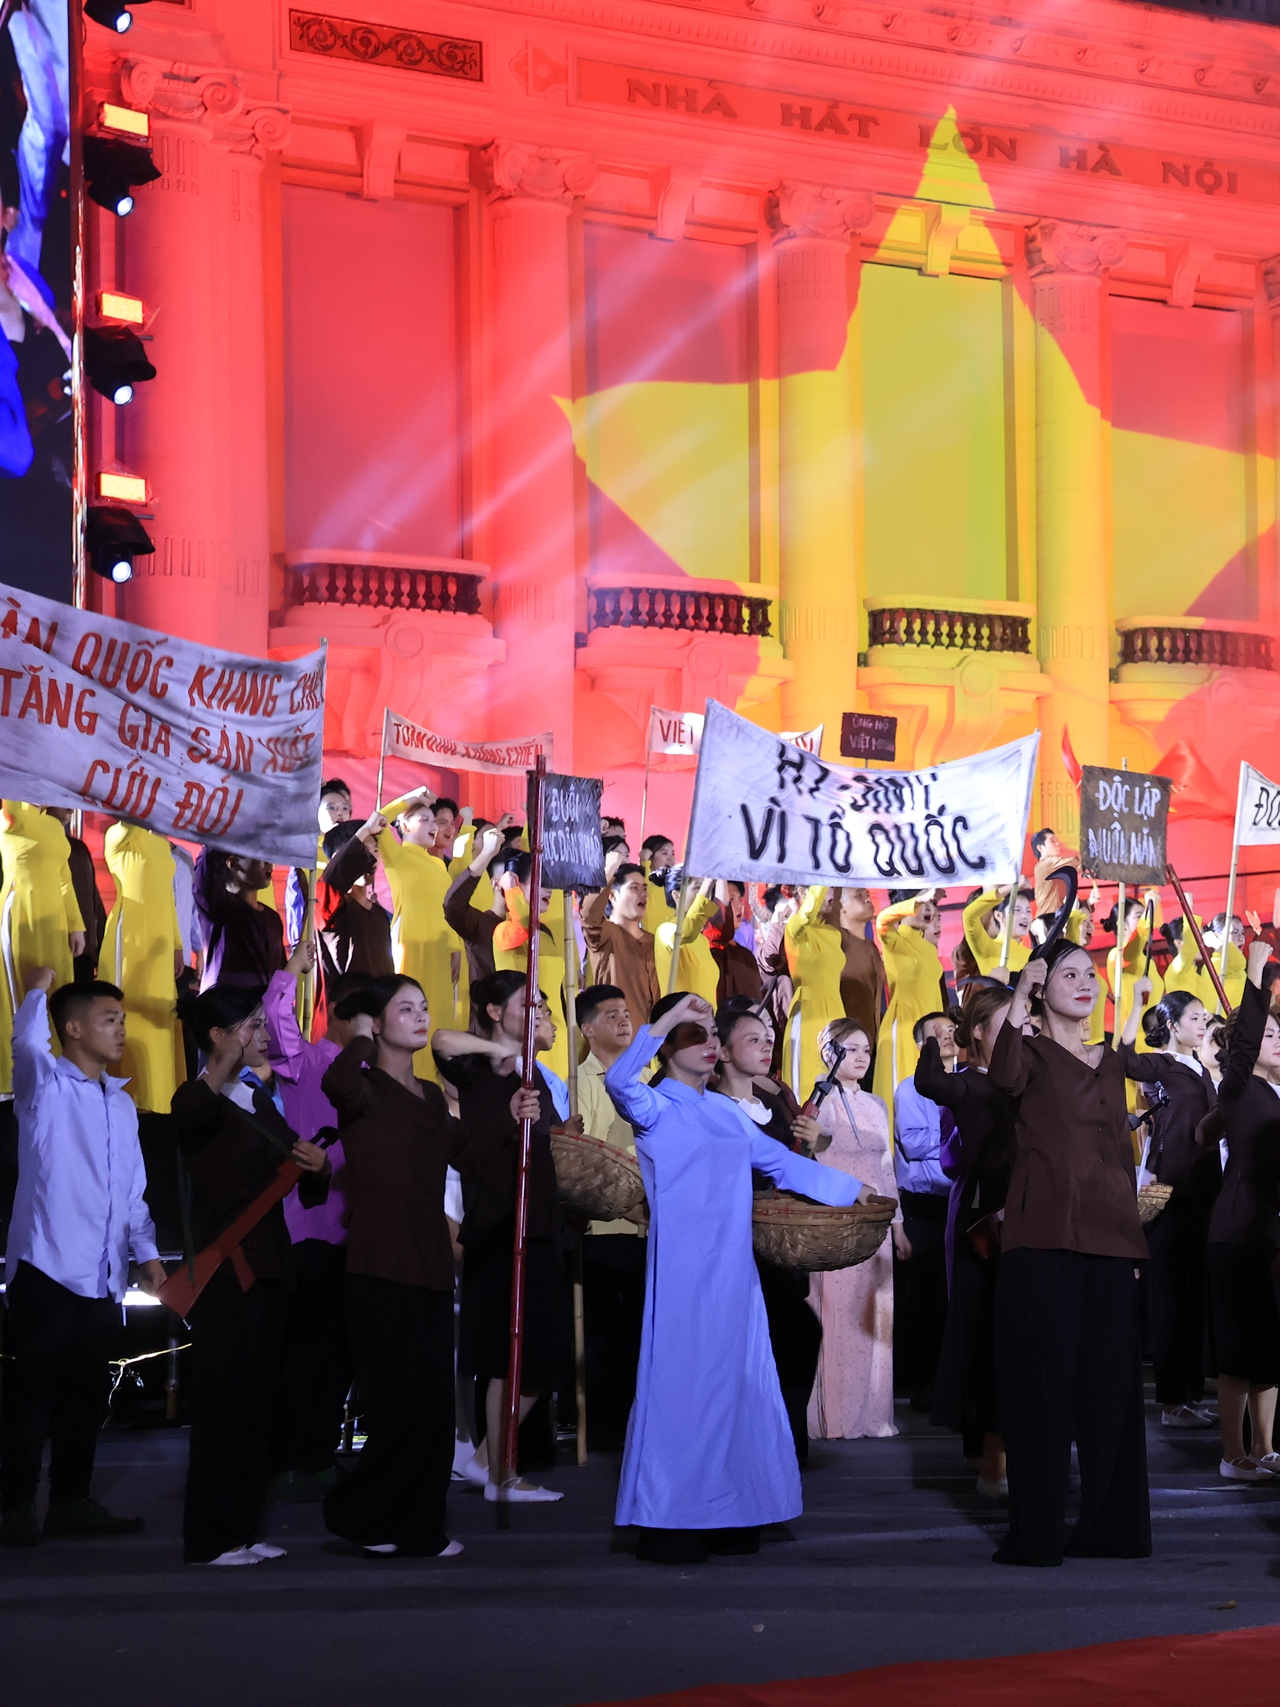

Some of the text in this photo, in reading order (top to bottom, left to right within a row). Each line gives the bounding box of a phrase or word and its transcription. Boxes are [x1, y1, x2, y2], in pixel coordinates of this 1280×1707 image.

[626, 78, 738, 119] NHÀ
[780, 100, 881, 139] HÁT
[1058, 143, 1123, 177] HÀ
[1161, 161, 1239, 196] NỘI
[71, 632, 175, 700] QUỐC
[0, 663, 99, 736] TĂNG
[117, 702, 172, 758] GIA
[393, 722, 428, 751] TOÀN
[171, 773, 245, 837] ĐÓI
[1095, 774, 1161, 821] ĐỘC LẬP
[740, 796, 986, 878] VÌ TỔ QUỐC
